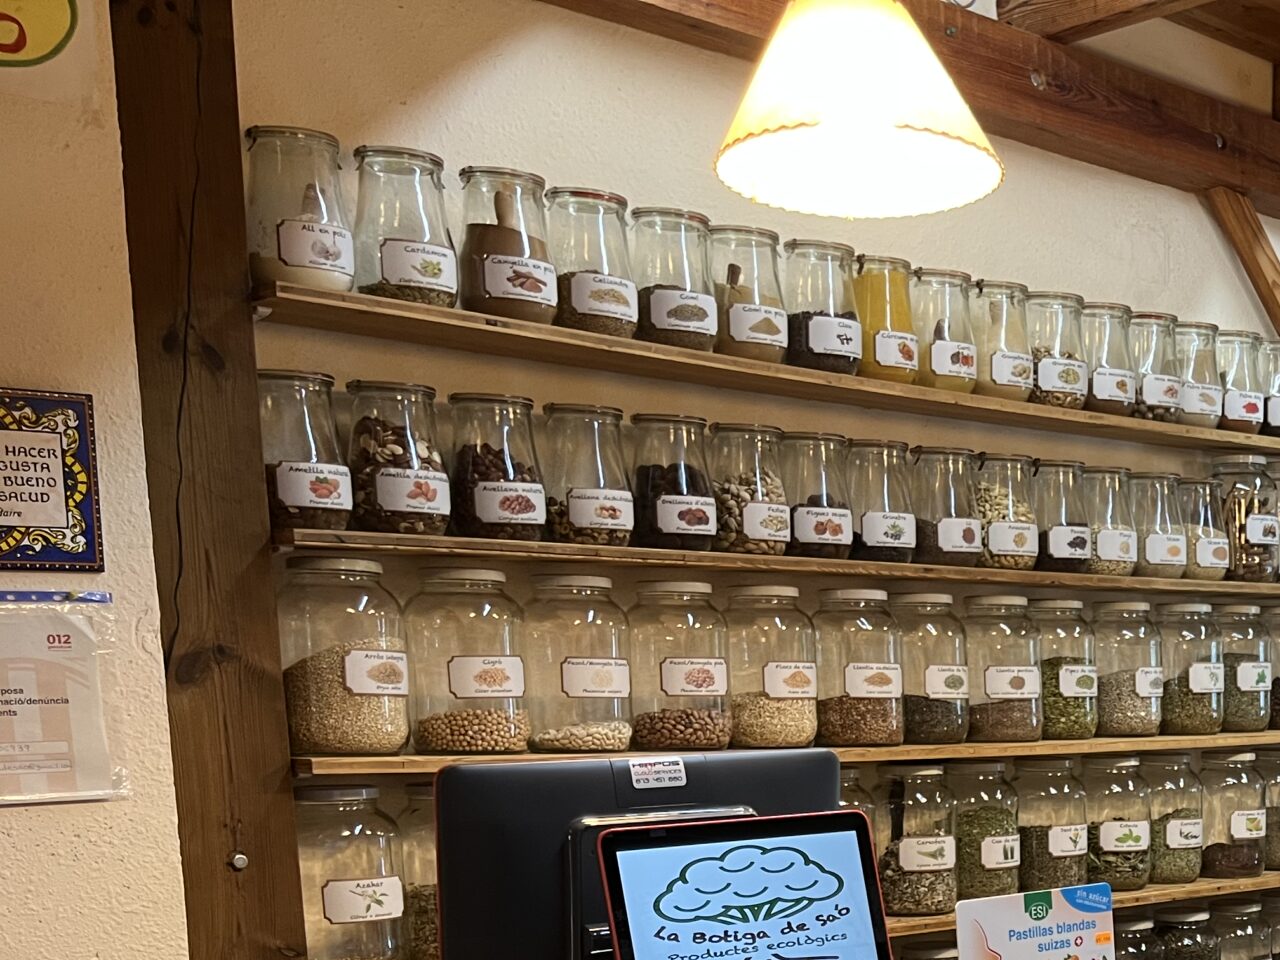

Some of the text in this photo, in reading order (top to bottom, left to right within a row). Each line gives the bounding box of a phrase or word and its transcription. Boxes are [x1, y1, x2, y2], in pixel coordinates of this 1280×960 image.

[5, 445, 58, 459] HACER
[0, 460, 50, 473] GUSTA
[3, 476, 57, 488] BUENO
[0, 491, 50, 503] SALUD
[46, 634, 72, 645] 012
[0, 688, 24, 696] posa
[1031, 906, 1047, 919] ESI
[654, 925, 681, 943] La
[692, 929, 769, 947] Botiga
[780, 922, 811, 936] de
[1008, 919, 1097, 942] Pastillas blandas
[766, 931, 849, 951] ecològics
[1037, 938, 1071, 953] suizas
